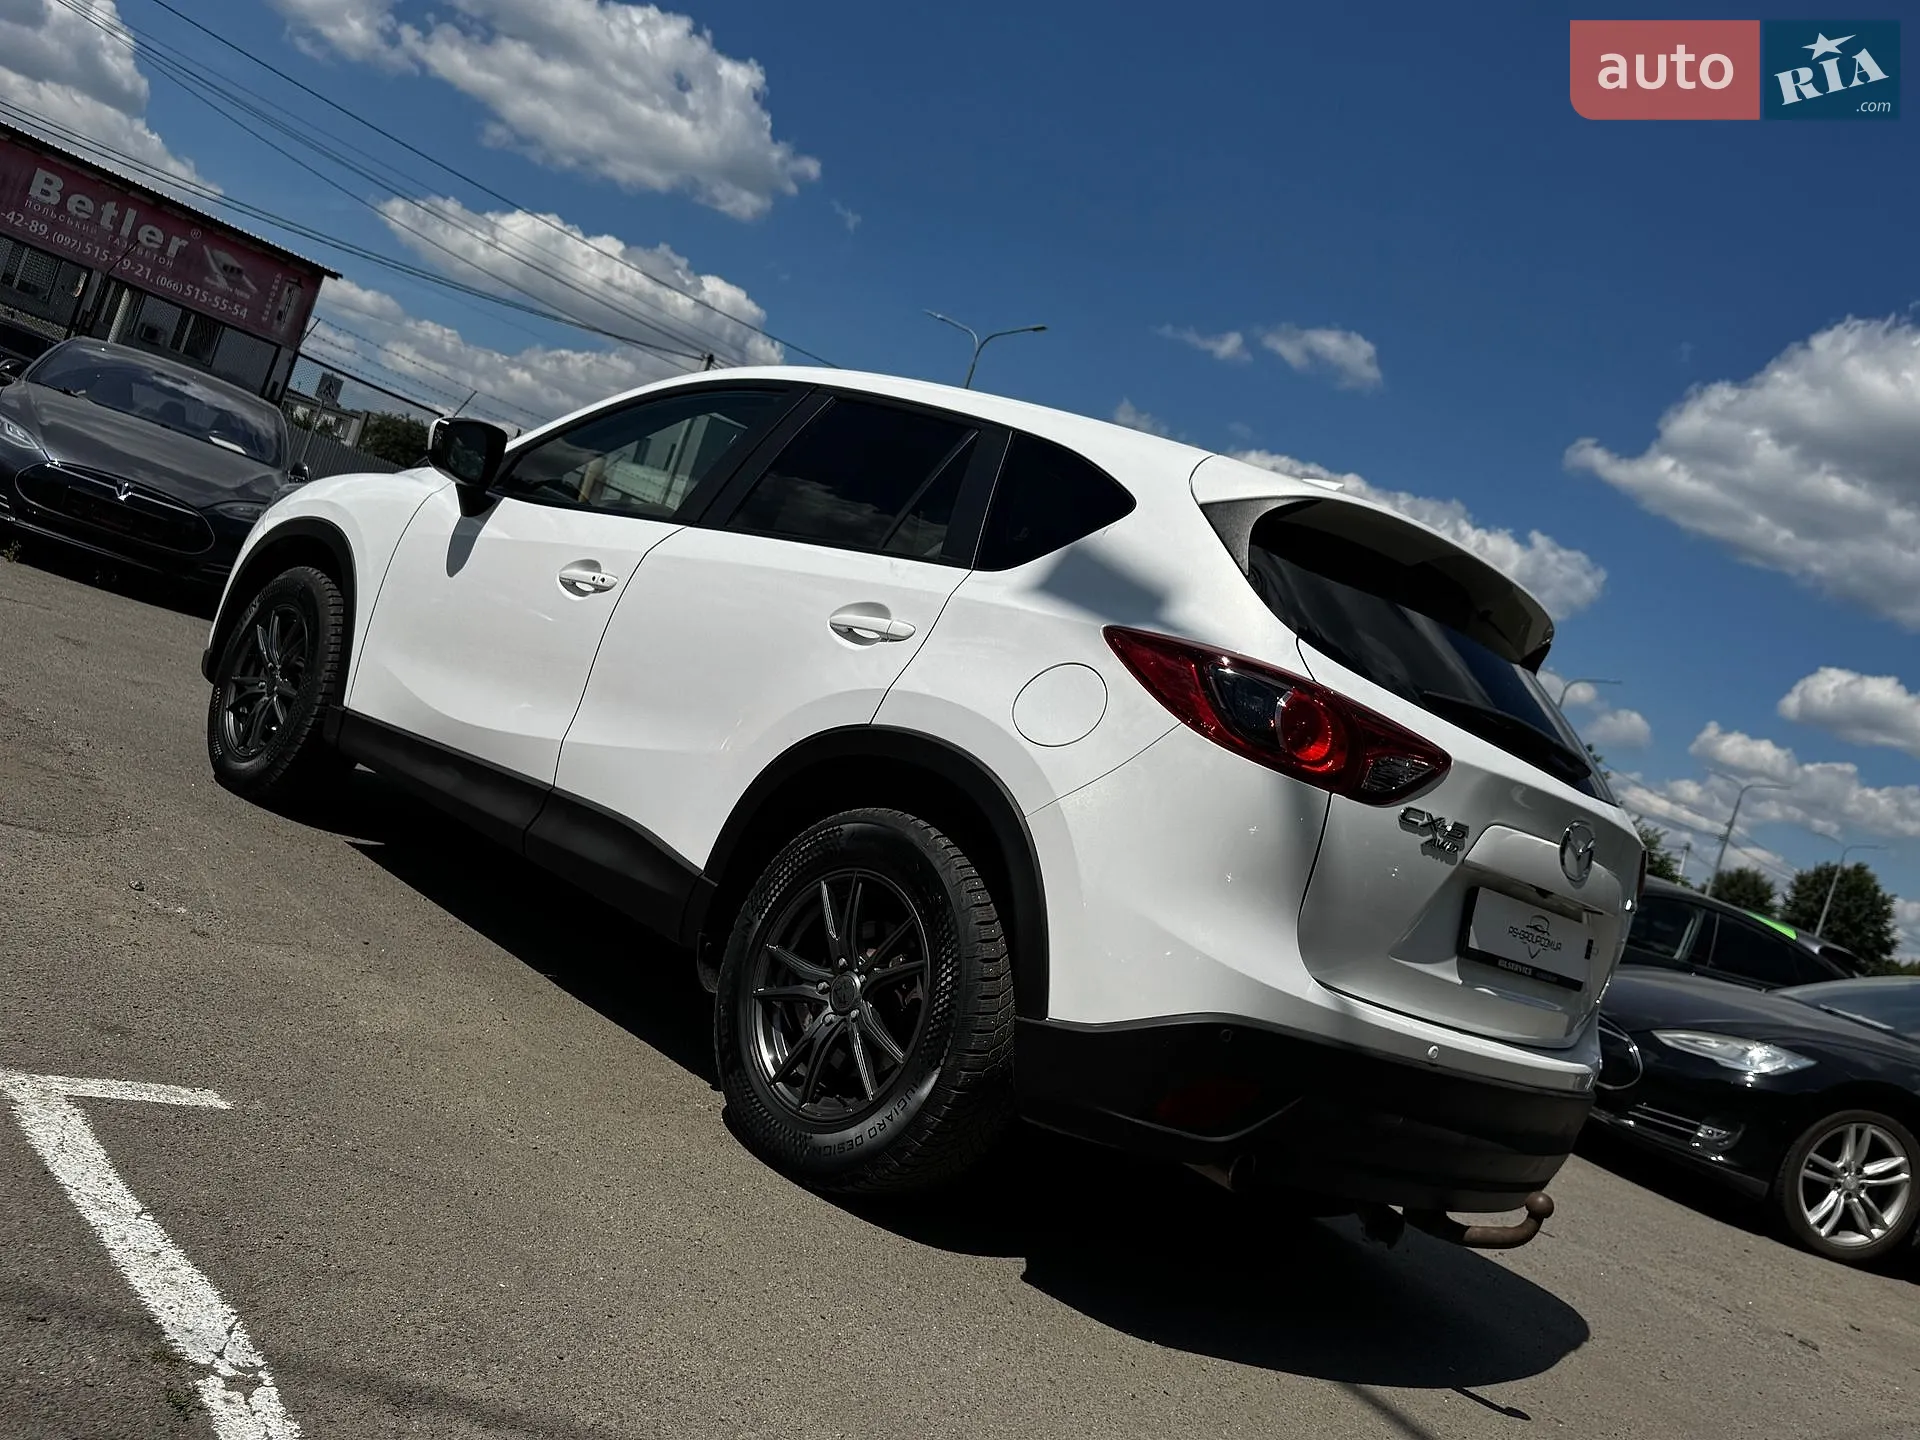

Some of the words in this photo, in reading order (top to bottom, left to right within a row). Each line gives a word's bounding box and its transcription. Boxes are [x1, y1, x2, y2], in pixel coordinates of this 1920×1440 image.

[28, 167, 189, 260] Betler
[52, 231, 82, 252] (097)
[184, 283, 248, 320] 515-55-54
